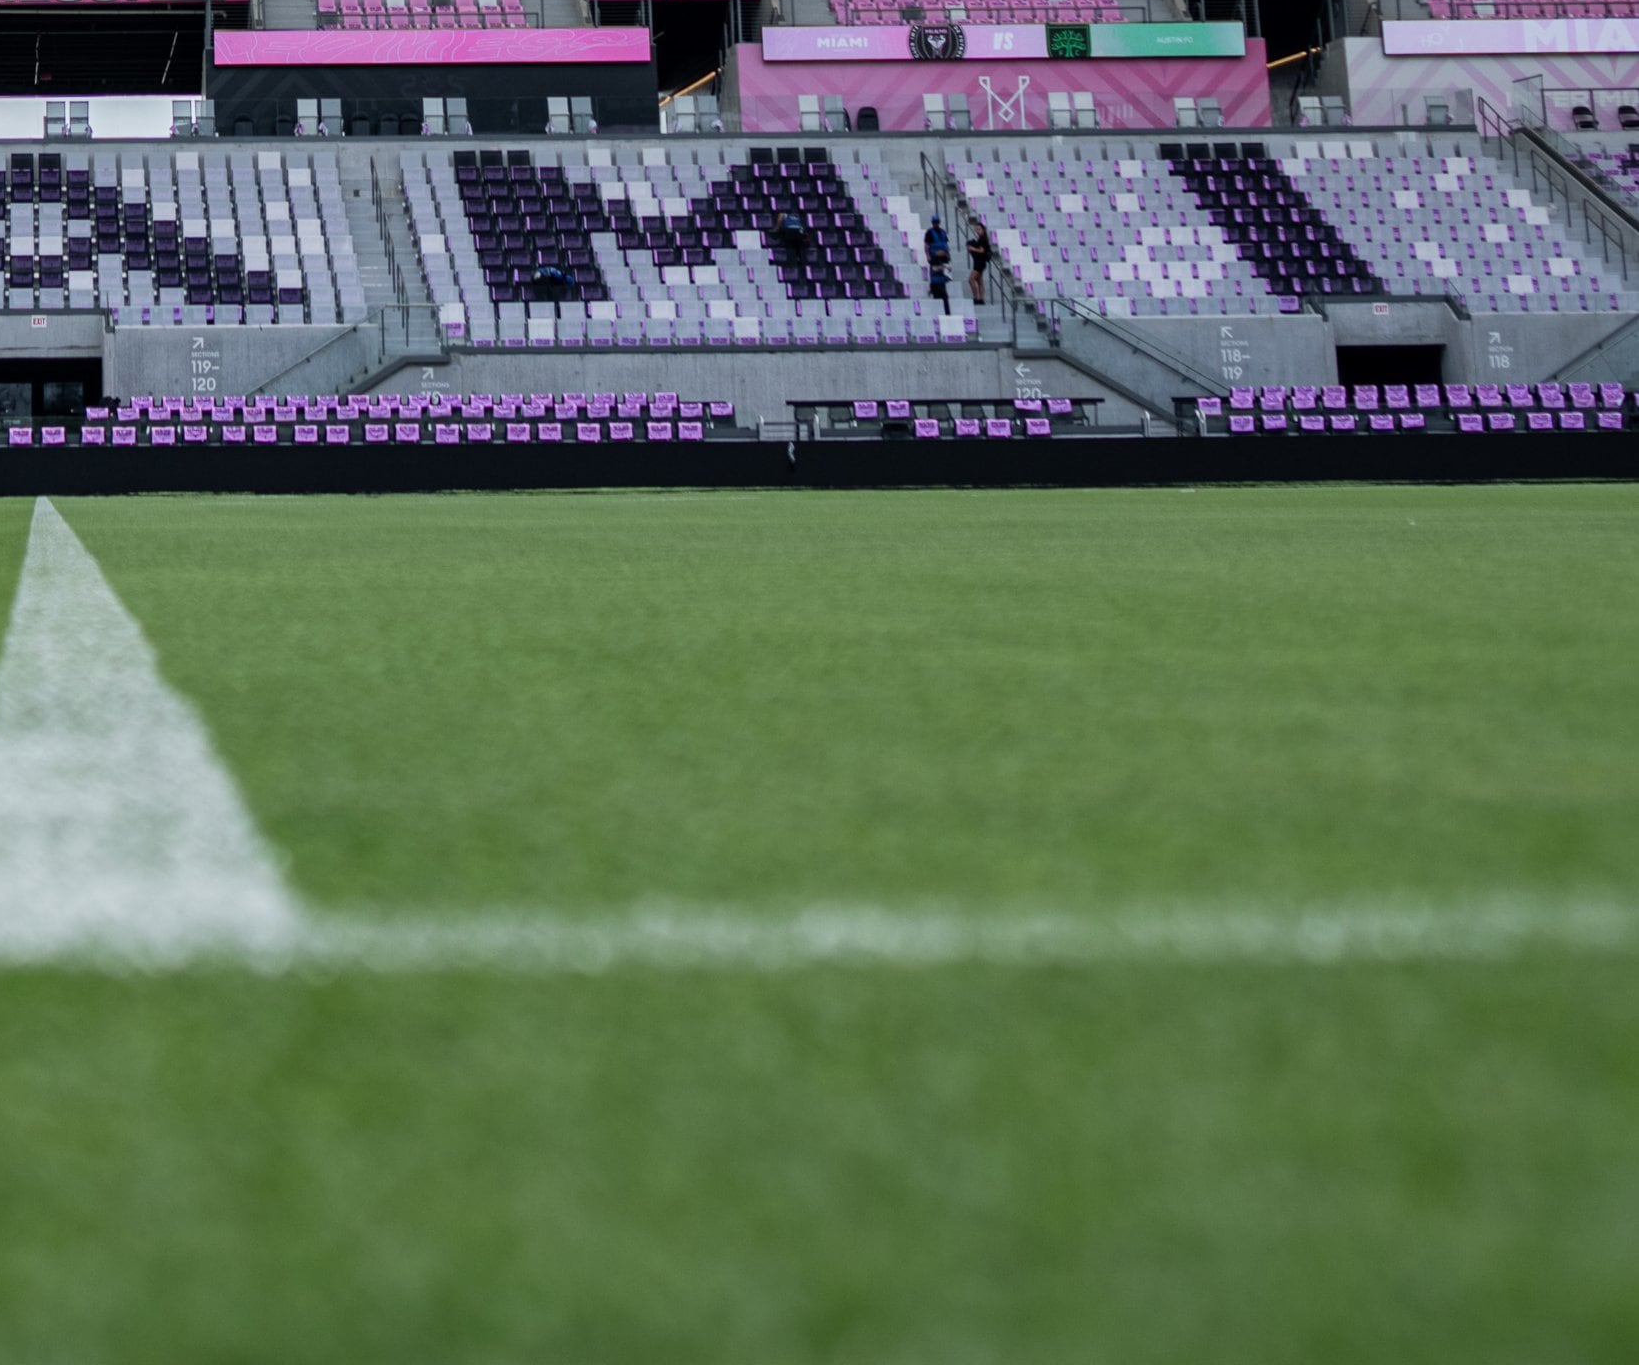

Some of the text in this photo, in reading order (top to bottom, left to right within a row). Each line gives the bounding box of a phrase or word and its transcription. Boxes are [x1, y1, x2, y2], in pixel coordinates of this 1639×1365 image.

[816, 37, 869, 48] MIAMI
[992, 31, 1014, 51] VS
[33, 317, 46, 326] EXIT
[1488, 355, 1510, 368] 118
[1222, 366, 1243, 380] 119
[192, 377, 216, 391] 120
